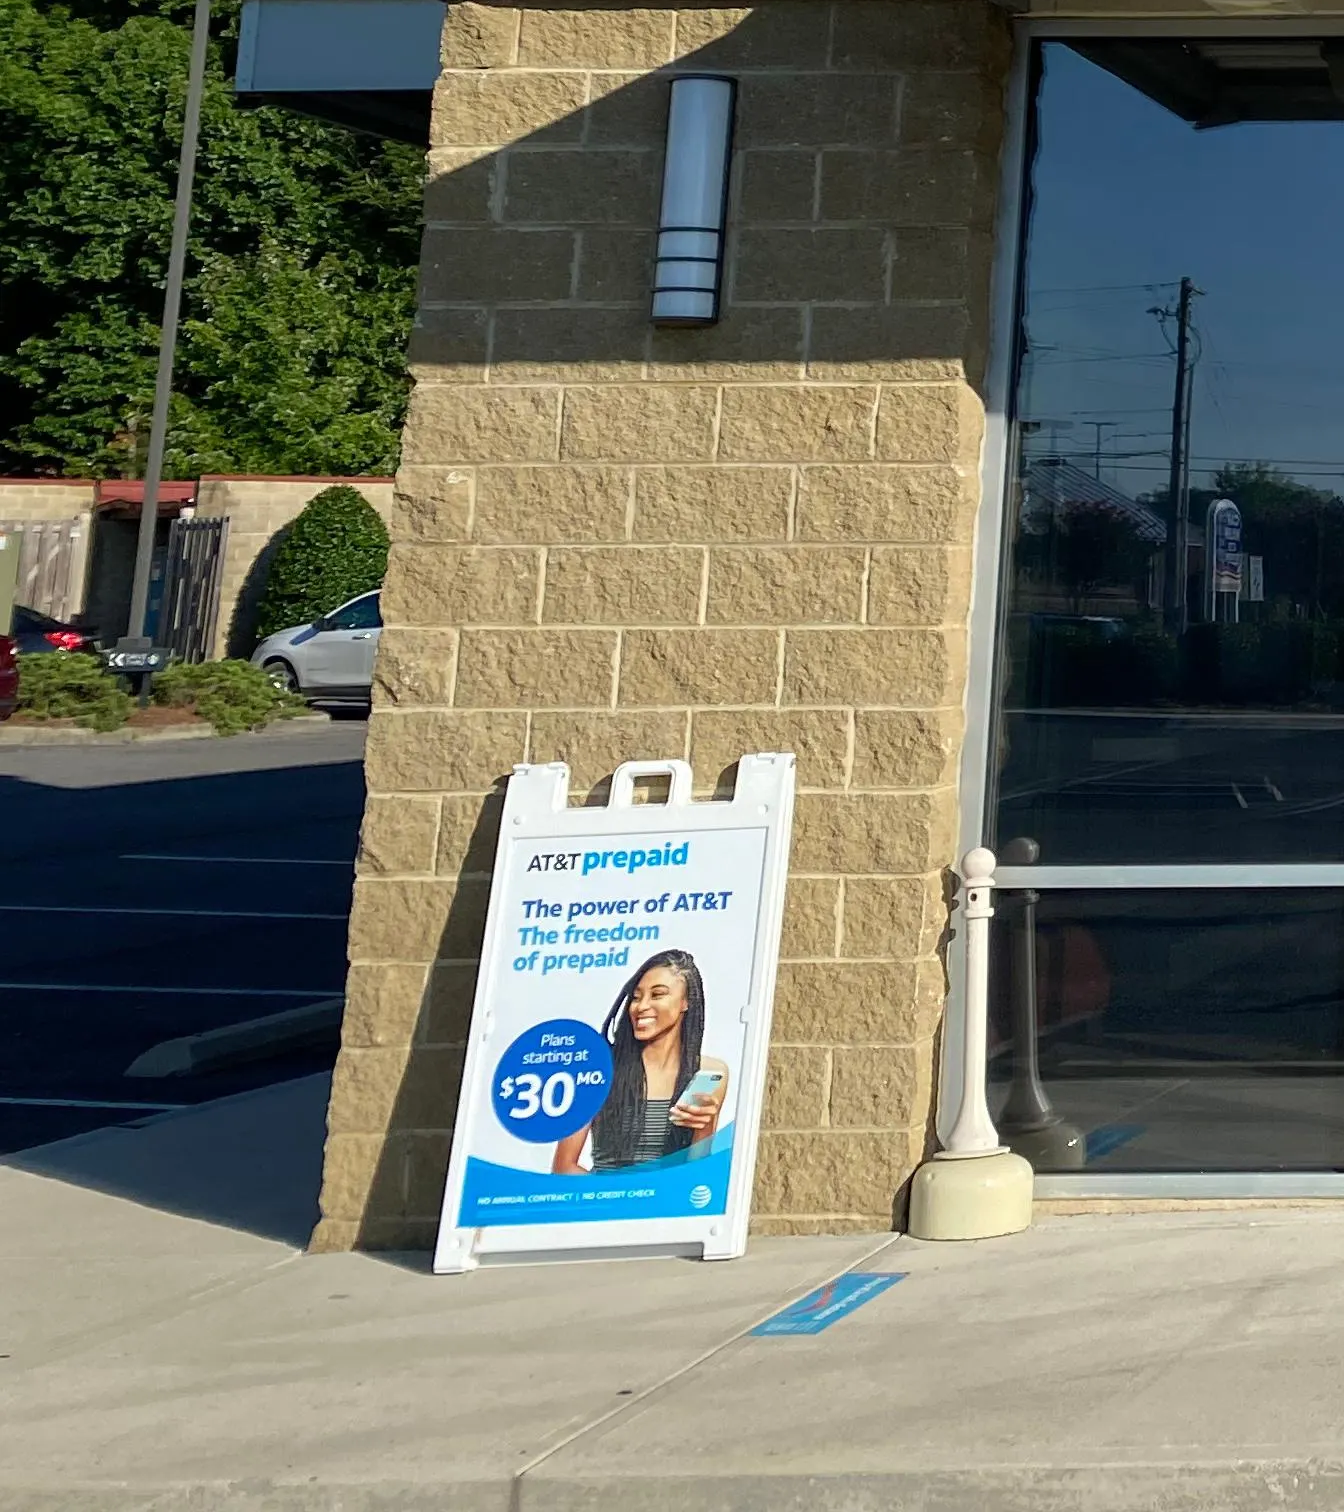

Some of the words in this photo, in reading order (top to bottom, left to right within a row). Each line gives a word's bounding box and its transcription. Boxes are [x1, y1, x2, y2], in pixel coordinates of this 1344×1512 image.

[526, 852, 581, 872] AT&T
[582, 841, 690, 875] prepaid
[522, 899, 562, 919] The
[567, 898, 639, 921] power
[644, 892, 670, 913] of
[672, 891, 733, 912] AT&T
[518, 925, 558, 946] The
[563, 922, 660, 944] freedom
[512, 951, 540, 972] of
[541, 946, 630, 975] prepaid
[540, 1033, 576, 1048] Plans
[522, 1050, 573, 1066] starting
[574, 1048, 590, 1062] at
[499, 1071, 575, 1119] $30
[576, 1071, 606, 1086] MO.
[527, 1192, 573, 1204] CONTRACT
